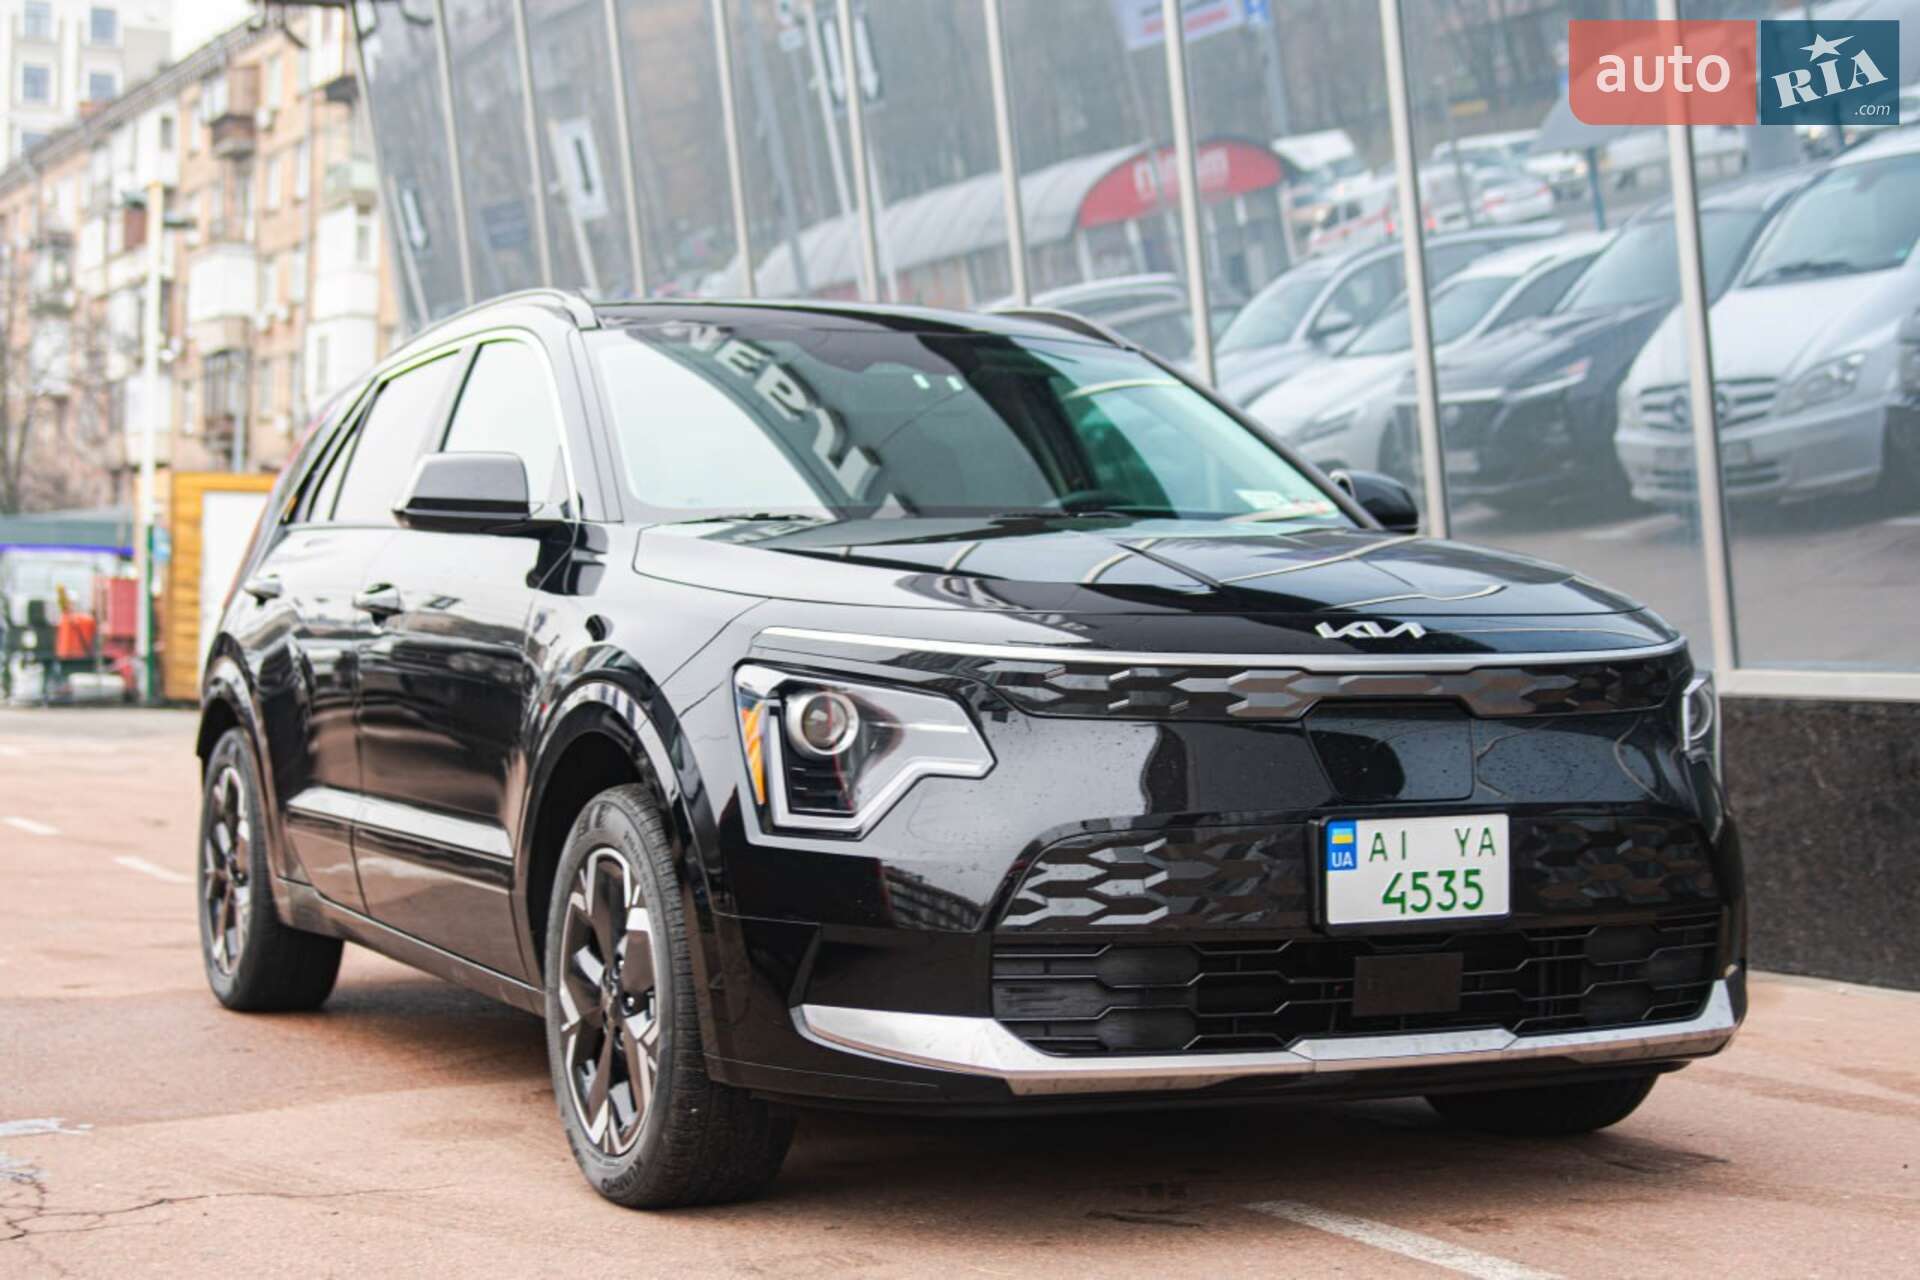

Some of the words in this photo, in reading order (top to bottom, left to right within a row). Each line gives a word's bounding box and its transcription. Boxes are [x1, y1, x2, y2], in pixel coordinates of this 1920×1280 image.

[1315, 622, 1427, 639] KIA
[1332, 851, 1354, 868] UA
[1382, 869, 1484, 914] 4535
